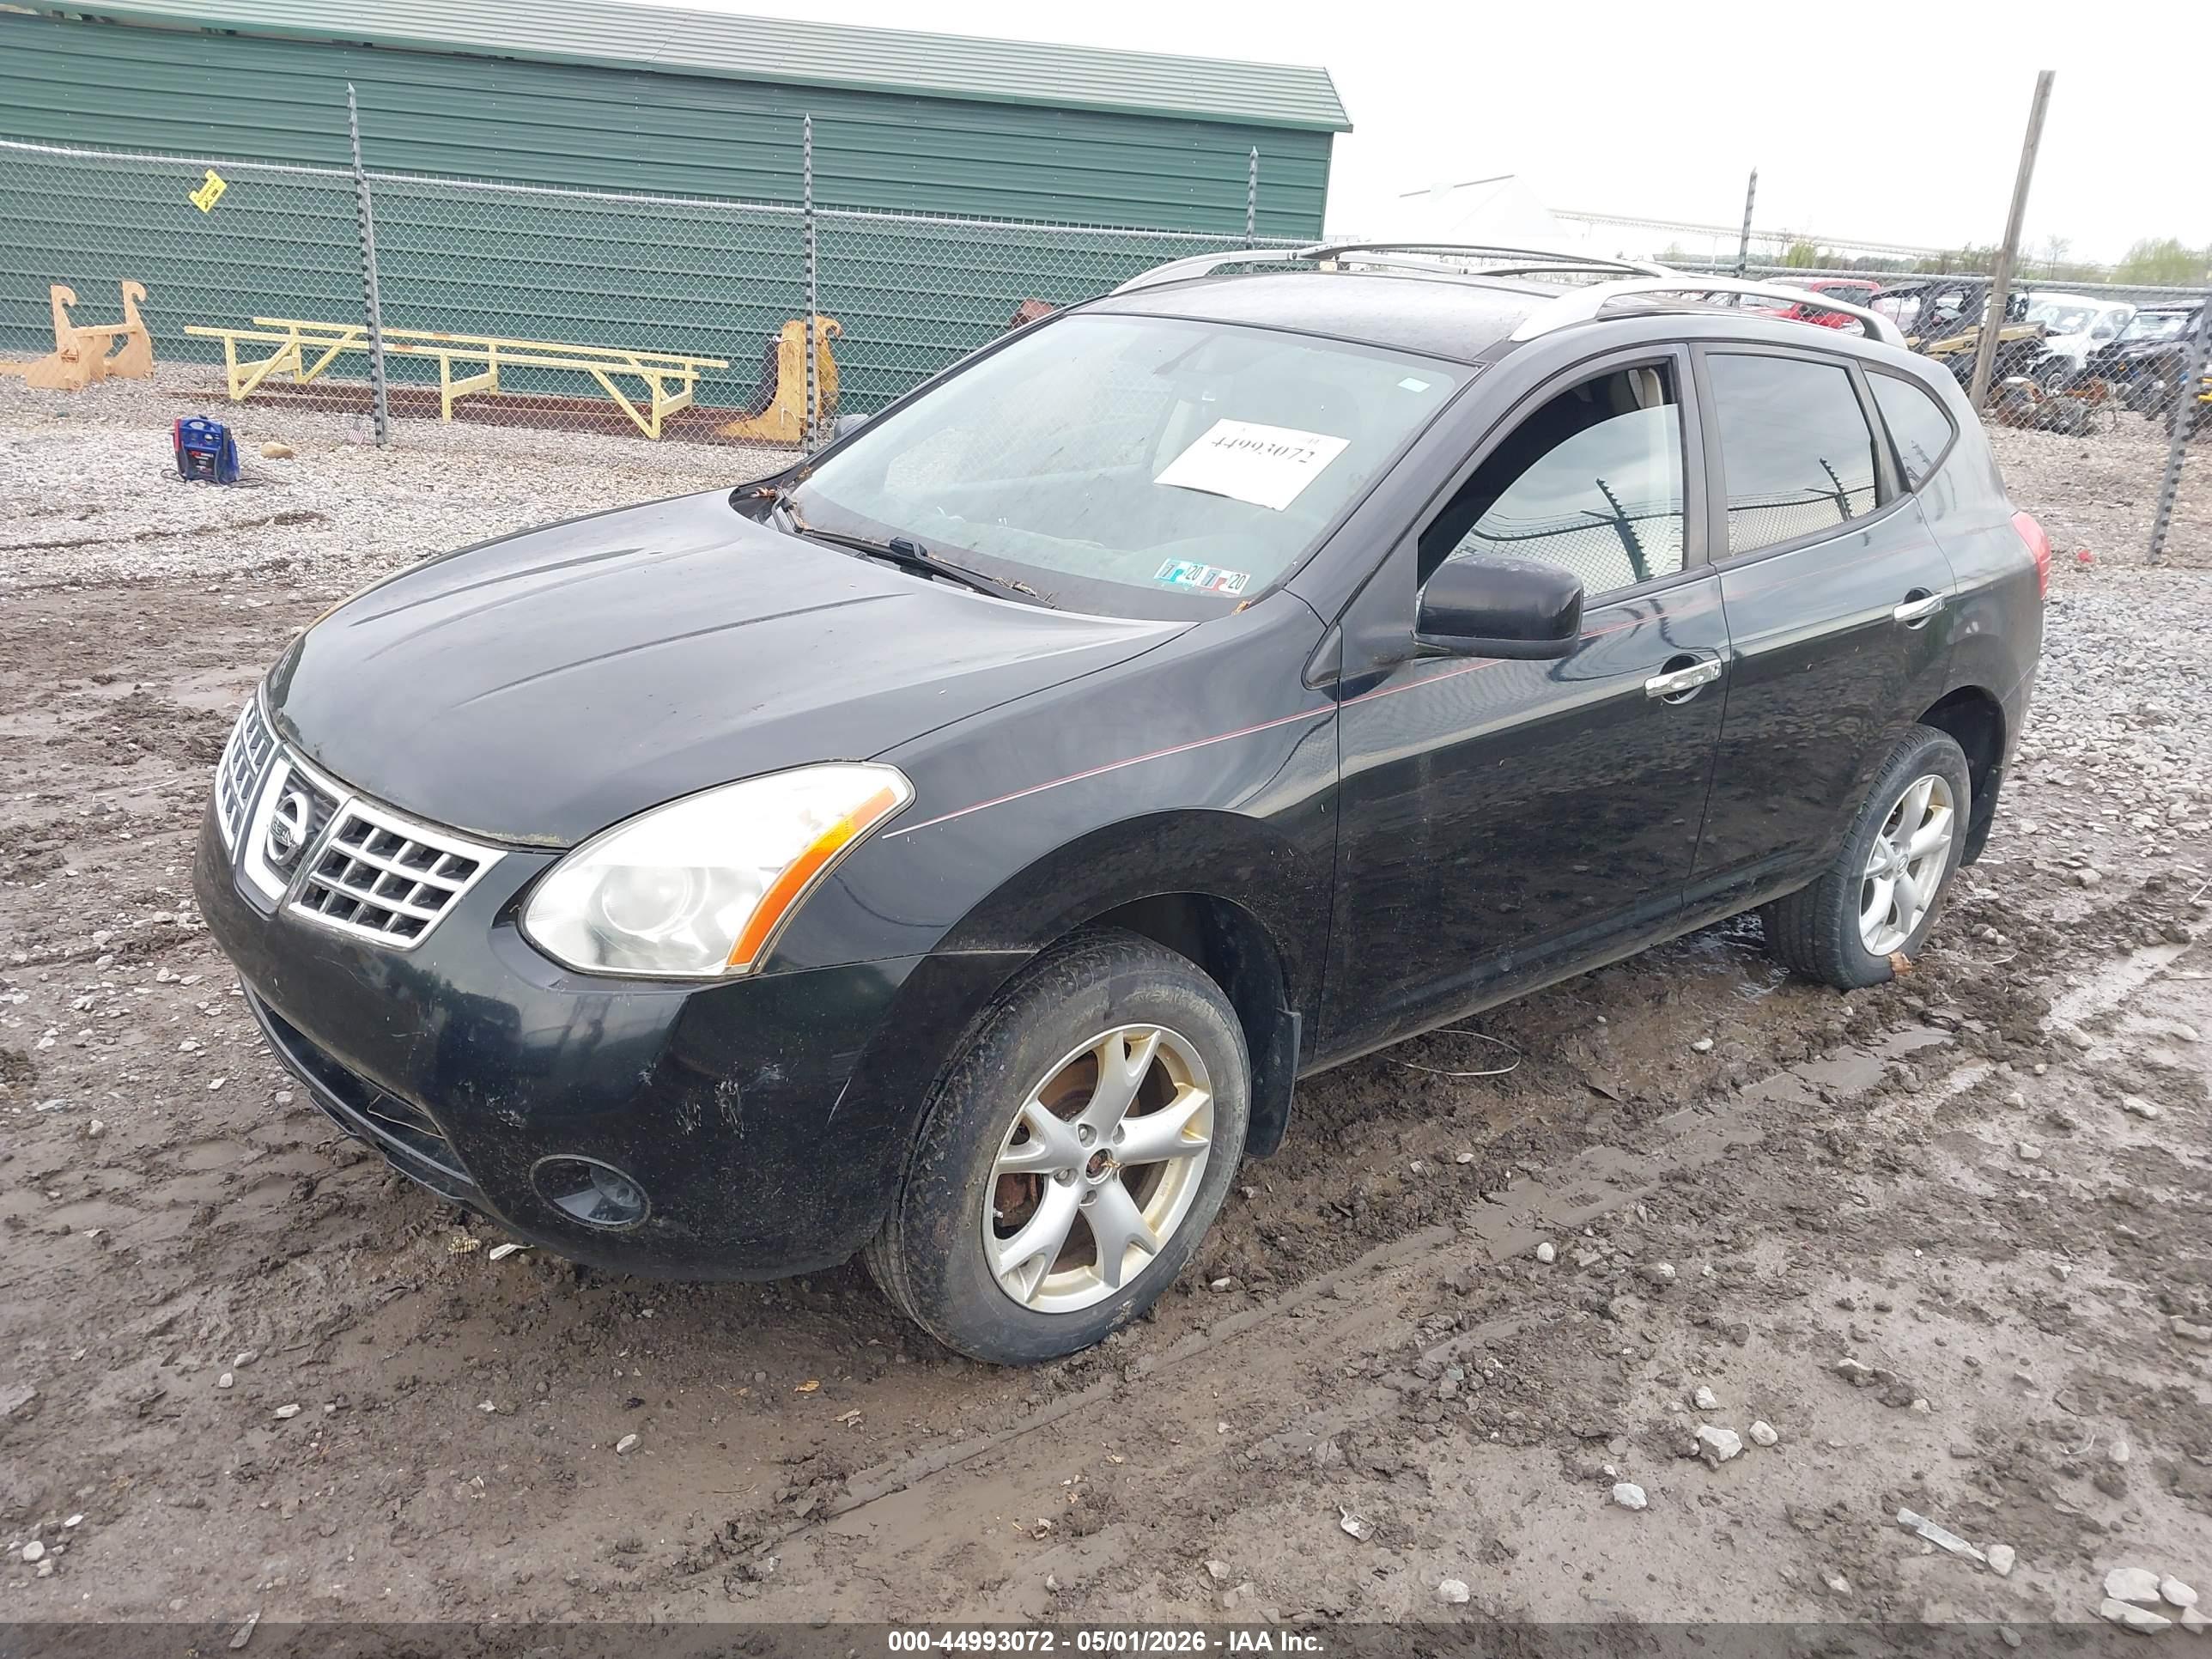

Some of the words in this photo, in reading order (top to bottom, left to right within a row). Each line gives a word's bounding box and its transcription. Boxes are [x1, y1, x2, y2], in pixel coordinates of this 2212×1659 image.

[1211, 436, 1316, 464] 44993072
[1185, 565, 1204, 580] 20
[1228, 574, 1247, 590] 20
